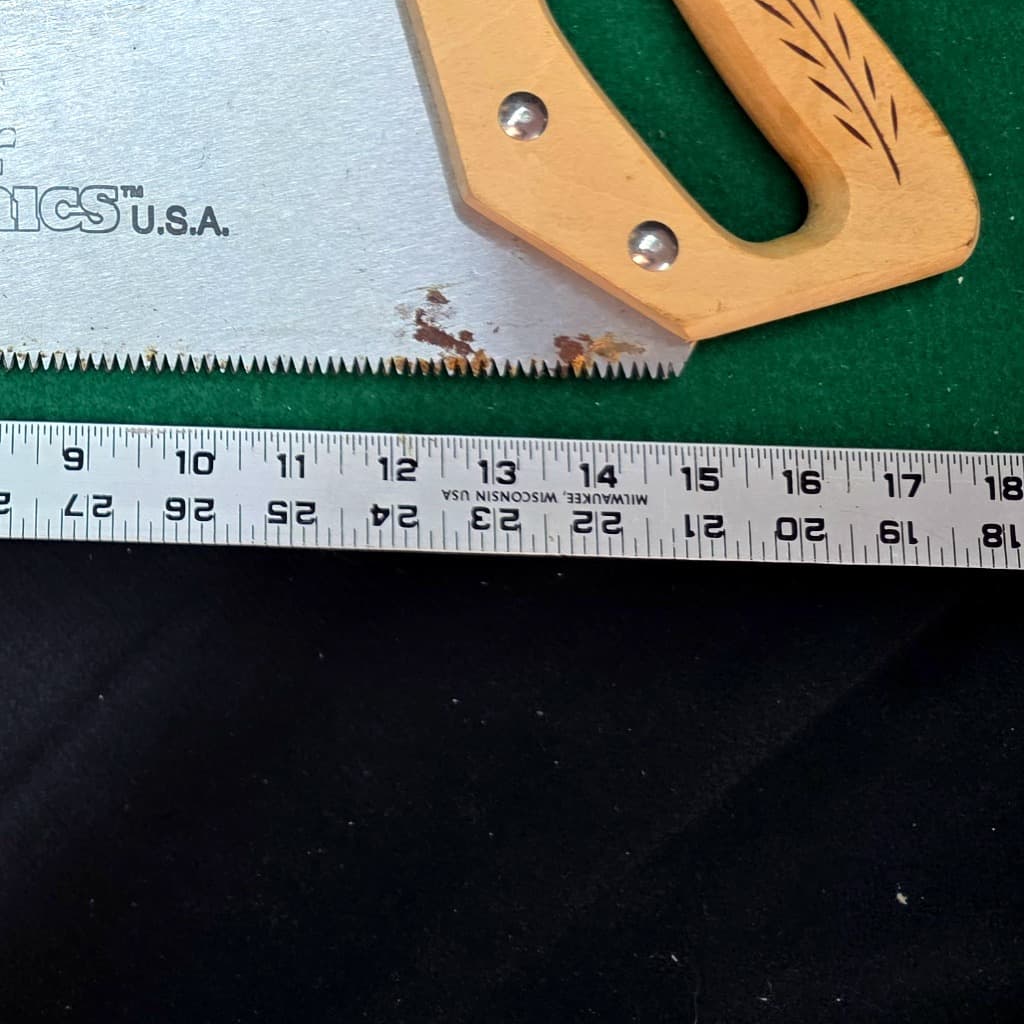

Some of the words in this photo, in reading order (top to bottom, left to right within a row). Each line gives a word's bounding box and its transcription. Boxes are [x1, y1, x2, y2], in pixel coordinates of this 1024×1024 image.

[132, 206, 230, 235] U.S.A.
[63, 448, 85, 471] 9
[176, 450, 214, 475] 10
[278, 454, 305, 478] 11
[378, 458, 418, 482] 12
[478, 460, 517, 485] 13
[580, 463, 618, 488] 14
[682, 467, 721, 492] 15
[783, 470, 823, 495] 16
[882, 473, 923, 498] 17
[984, 476, 1024, 501] 18
[64, 494, 113, 518] 27
[442, 489, 472, 501] USA
[476, 491, 558, 504] WISCONSIN
[562, 491, 648, 506] MILWAUKEE,
[165, 498, 215, 522] 26
[269, 501, 317, 525] 25
[372, 505, 418, 529] 24
[472, 508, 520, 532] 23
[573, 511, 623, 535] 22
[683, 515, 726, 539] 21
[777, 517, 826, 542] 20
[881, 521, 918, 545] 19
[982, 524, 1022, 548] 18
